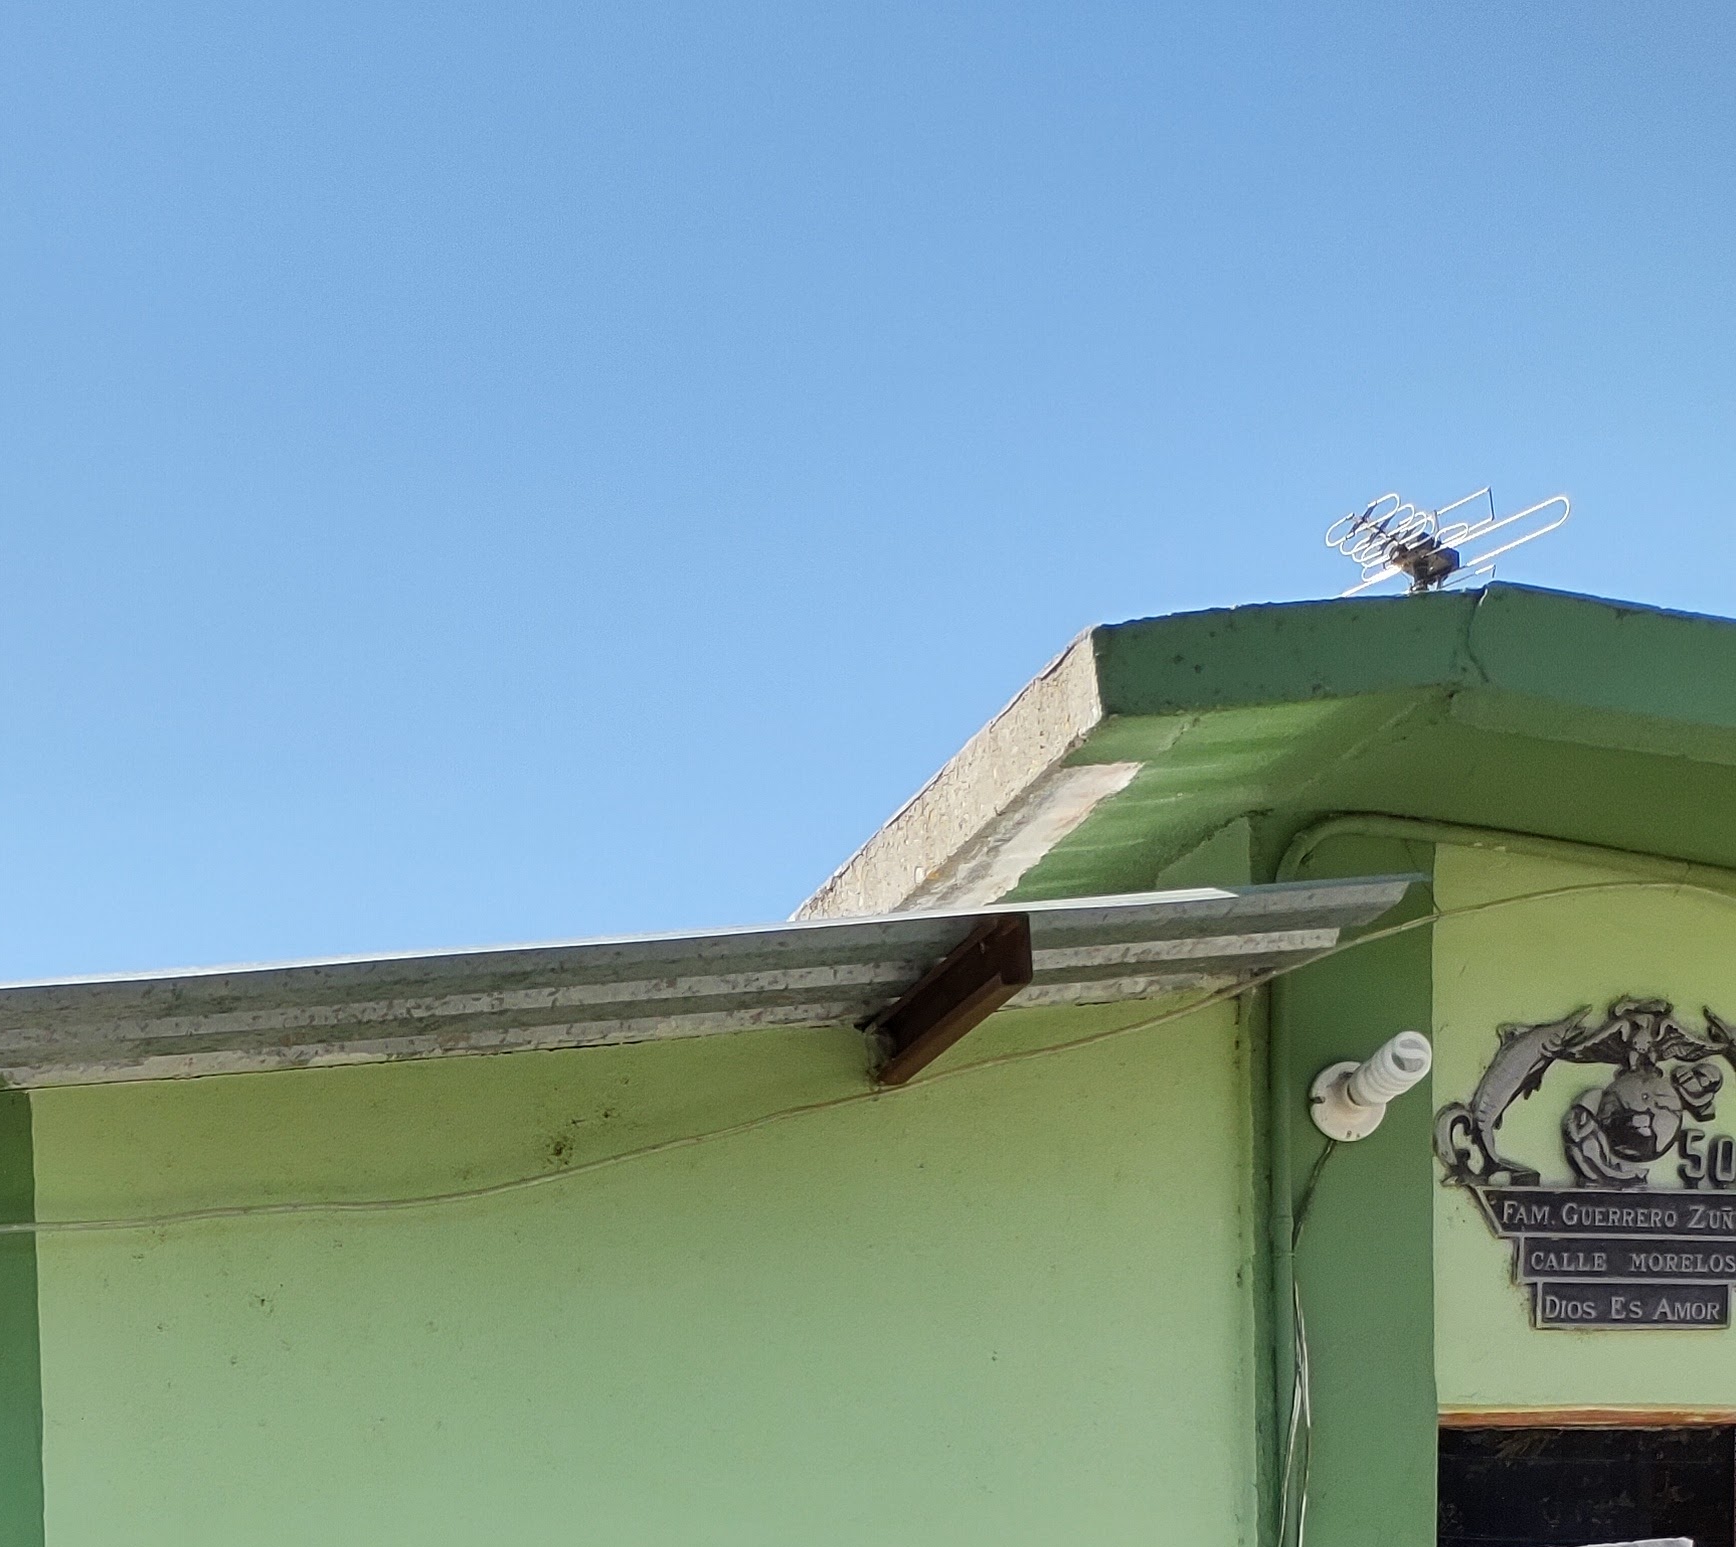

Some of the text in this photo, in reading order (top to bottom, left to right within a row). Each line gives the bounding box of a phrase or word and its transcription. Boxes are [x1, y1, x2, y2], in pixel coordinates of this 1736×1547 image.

[1501, 1200, 1556, 1227] FAM.
[1562, 1202, 1677, 1229] GUERRERO
[1530, 1252, 1736, 1274] CALLE MORELOS
[1543, 1295, 1720, 1320] DIOS ES AMOR
